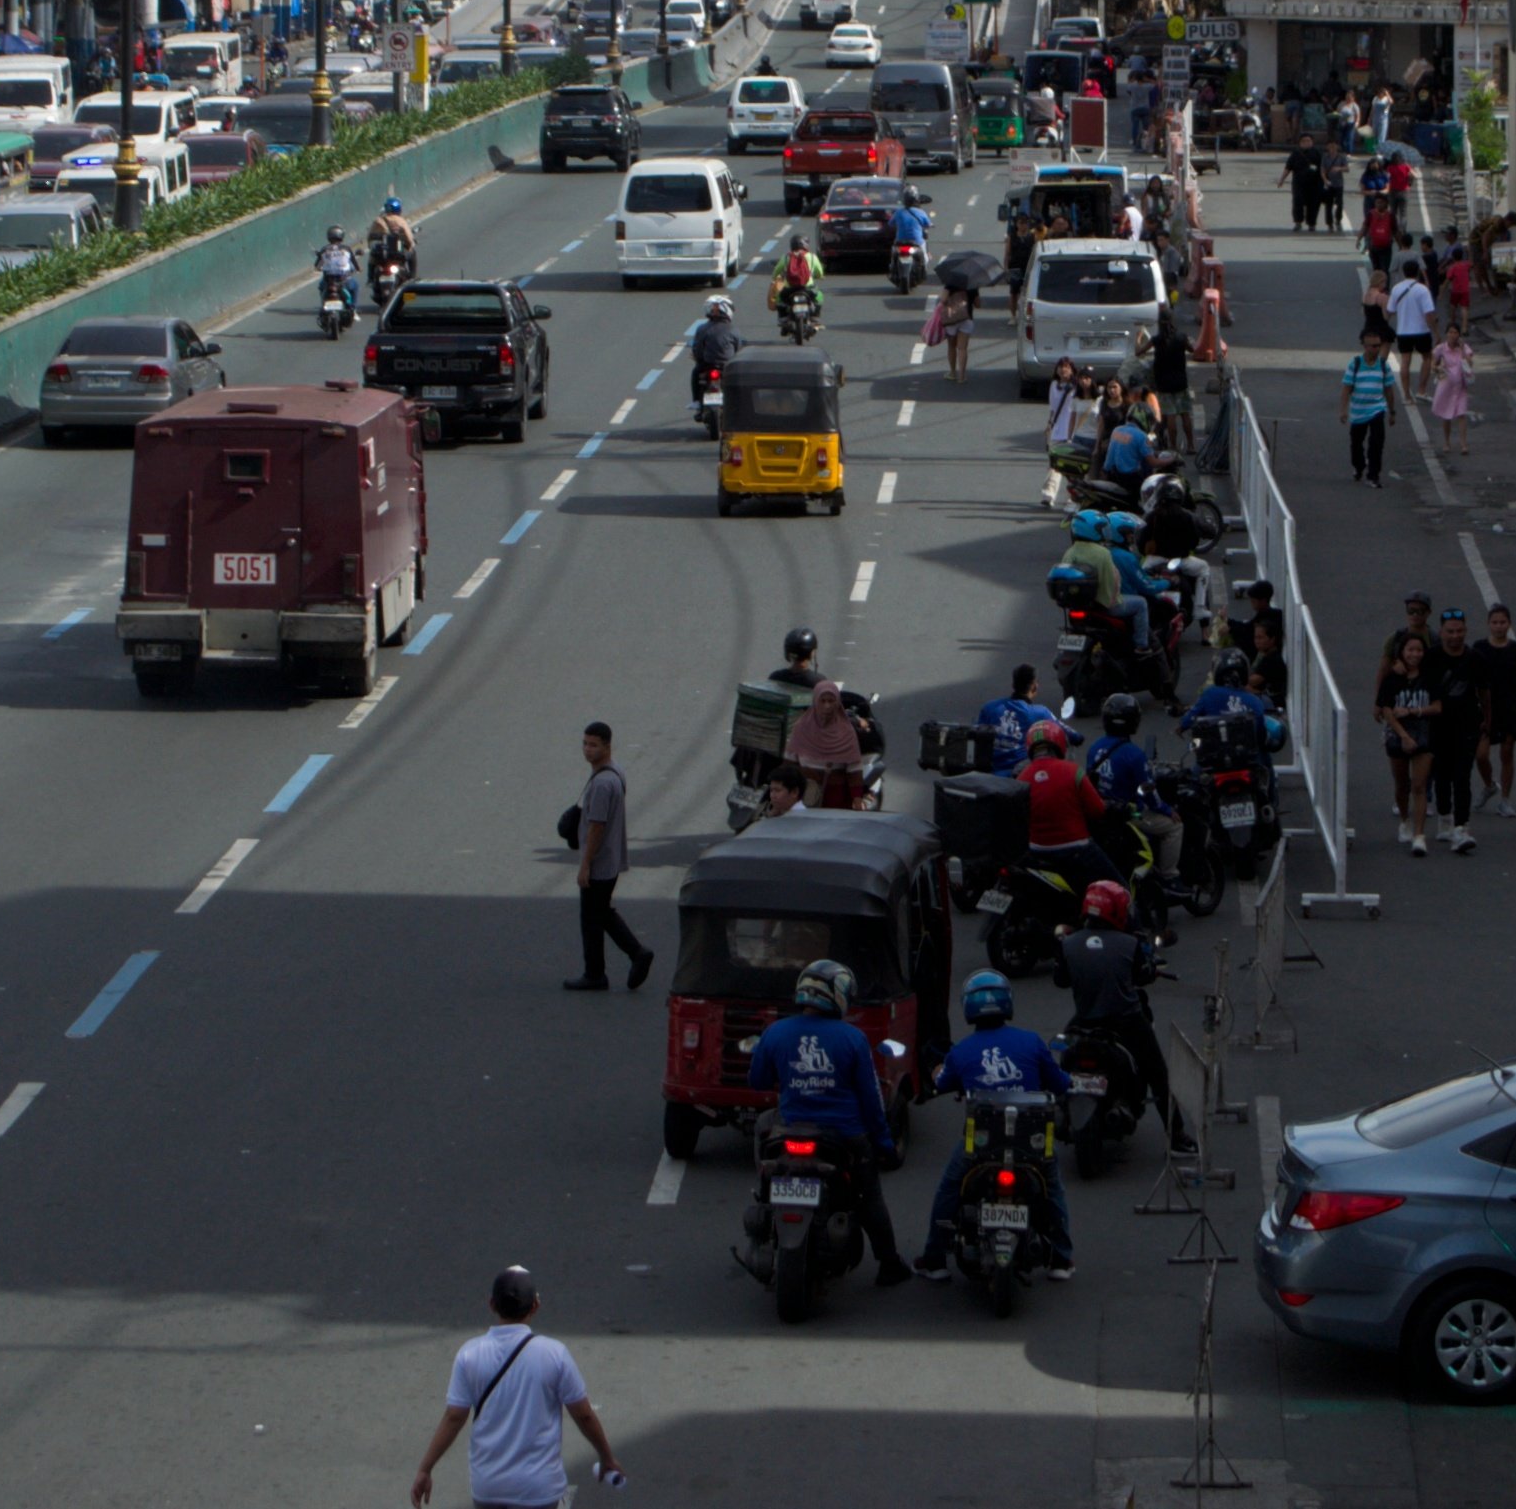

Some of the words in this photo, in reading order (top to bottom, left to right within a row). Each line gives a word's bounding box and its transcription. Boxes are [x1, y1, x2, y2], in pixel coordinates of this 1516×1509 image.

[1188, 21, 1238, 39] PULIS
[386, 49, 401, 57] NO
[381, 57, 408, 66] ENTRY
[393, 358, 484, 374] CONQUEST
[223, 558, 273, 582] 5051
[789, 1076, 835, 1090] JoyRide
